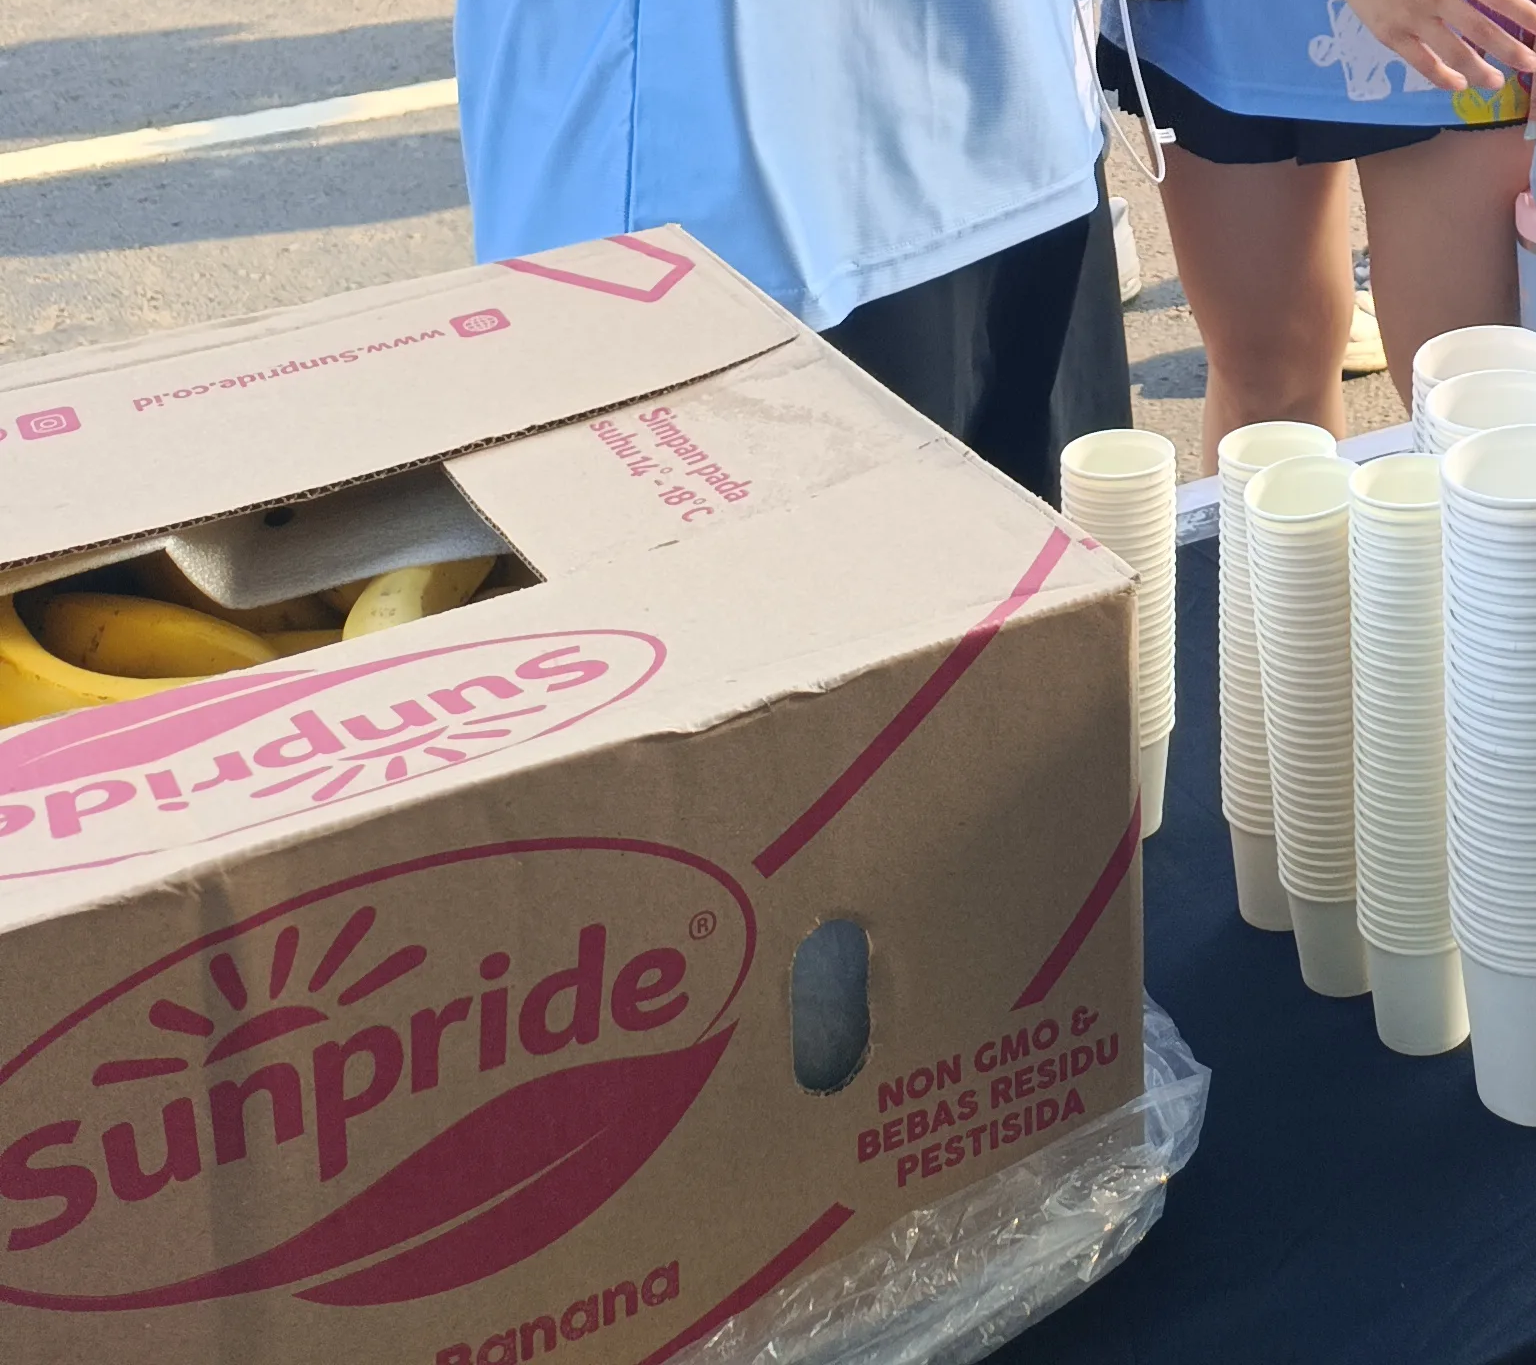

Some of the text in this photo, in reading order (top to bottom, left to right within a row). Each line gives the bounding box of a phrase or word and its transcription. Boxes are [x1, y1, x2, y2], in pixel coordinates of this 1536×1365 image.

[133, 327, 446, 412] www.Sunpride.co.id
[589, 420, 642, 459] suhu
[638, 406, 752, 503] Simpan pada
[0, 922, 690, 1251] Sunpride
[857, 1032, 1119, 1164] BEBAS RESIDU
[877, 1005, 1099, 1114] NON GMO &
[897, 1087, 1086, 1188] PESTISIDA
